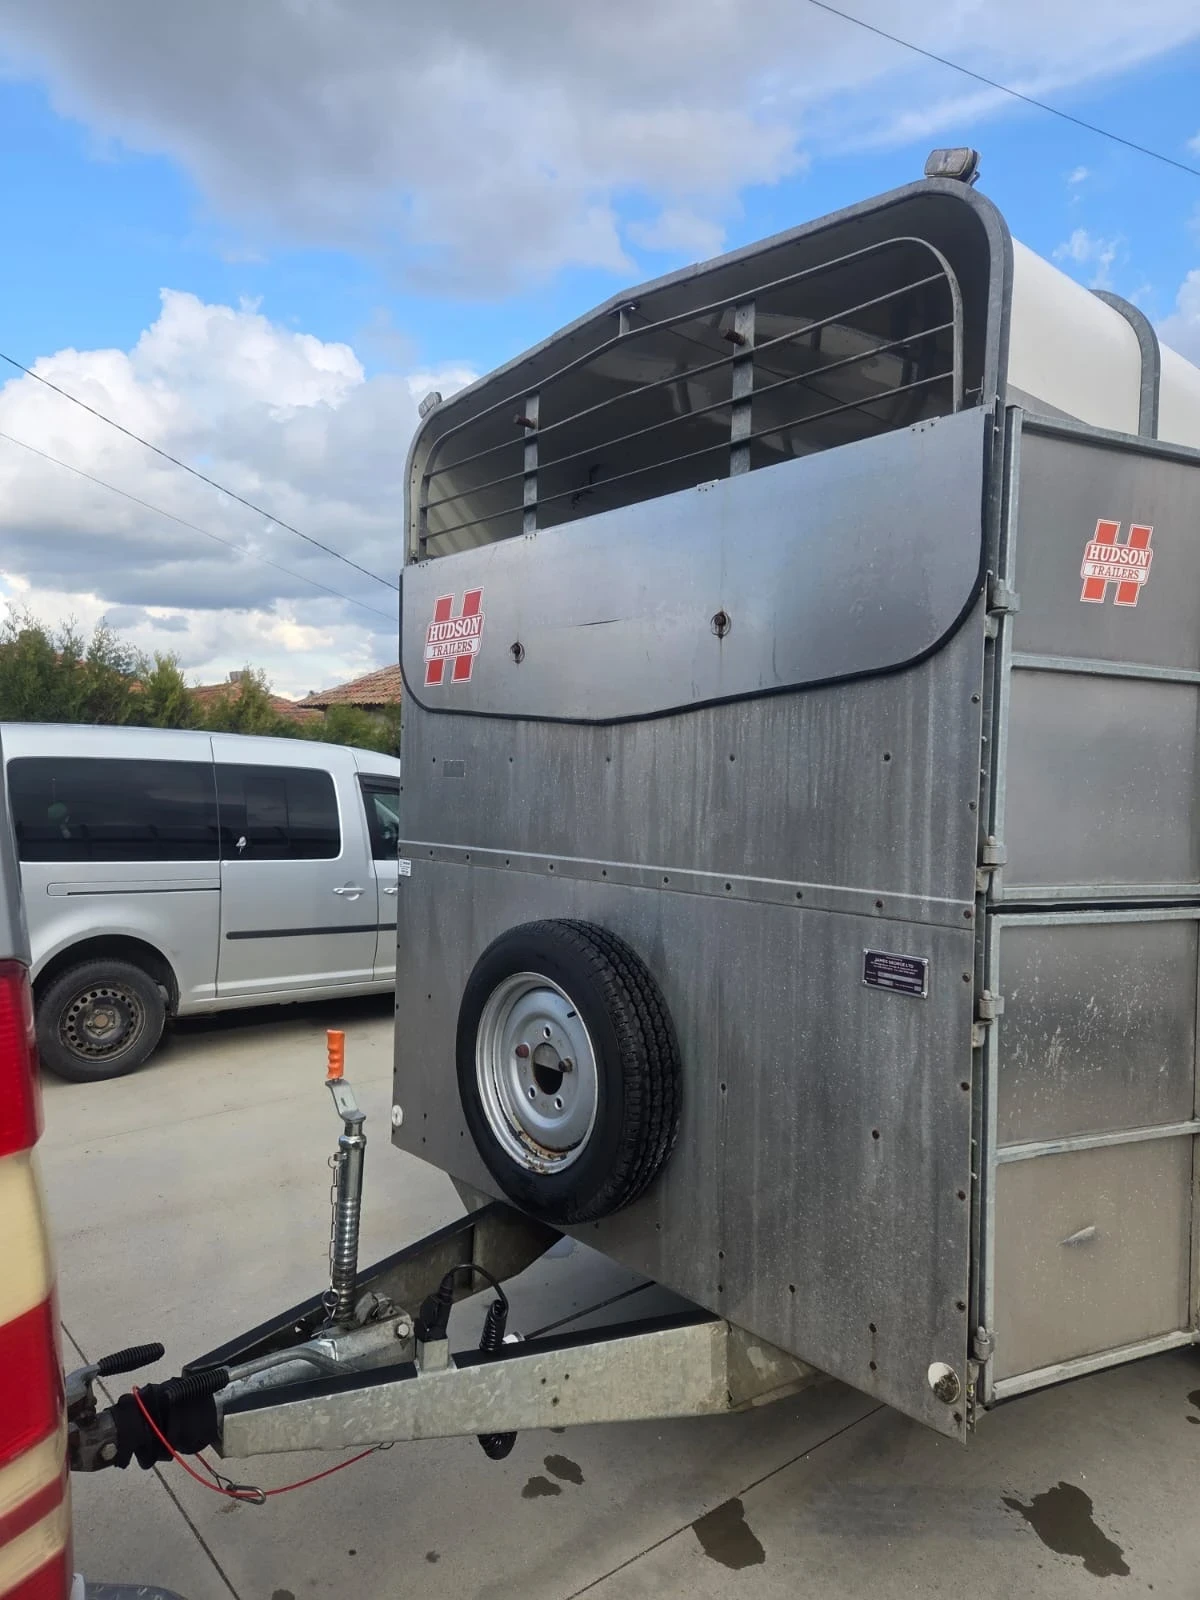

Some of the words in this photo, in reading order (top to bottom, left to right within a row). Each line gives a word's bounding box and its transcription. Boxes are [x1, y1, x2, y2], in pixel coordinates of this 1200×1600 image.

[1087, 544, 1150, 566] HUDSON
[1091, 564, 1140, 580] TRAILERS
[428, 616, 482, 642] HUDSON
[432, 640, 473, 657] TRAILERS
